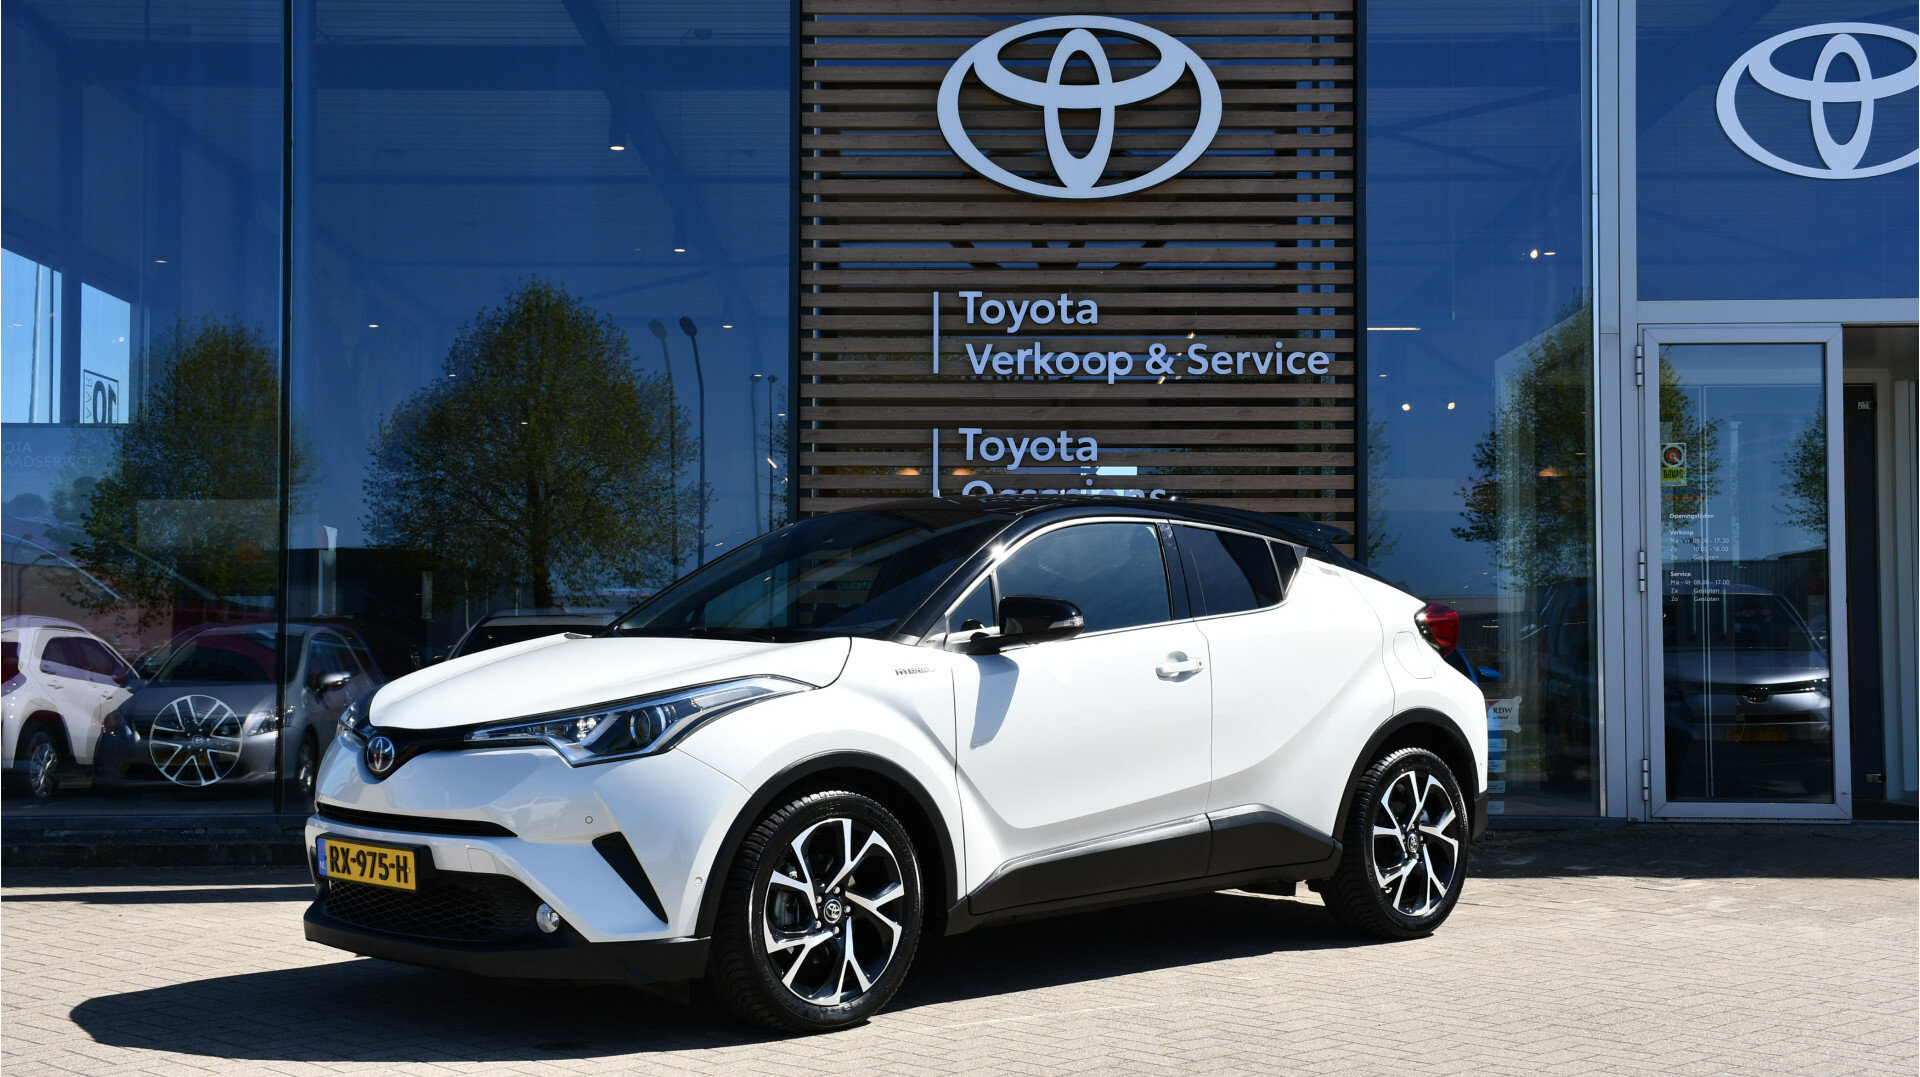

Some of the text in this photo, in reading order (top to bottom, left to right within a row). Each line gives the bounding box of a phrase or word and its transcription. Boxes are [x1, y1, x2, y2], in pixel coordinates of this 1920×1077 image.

[958, 290, 1098, 333] Toyota
[965, 341, 1330, 384] Verkoop & Service
[3, 442, 32, 454] OTA
[3, 456, 96, 468] AADSERVICE
[958, 427, 1098, 470] Toyota
[329, 845, 409, 884] RX-975-H
